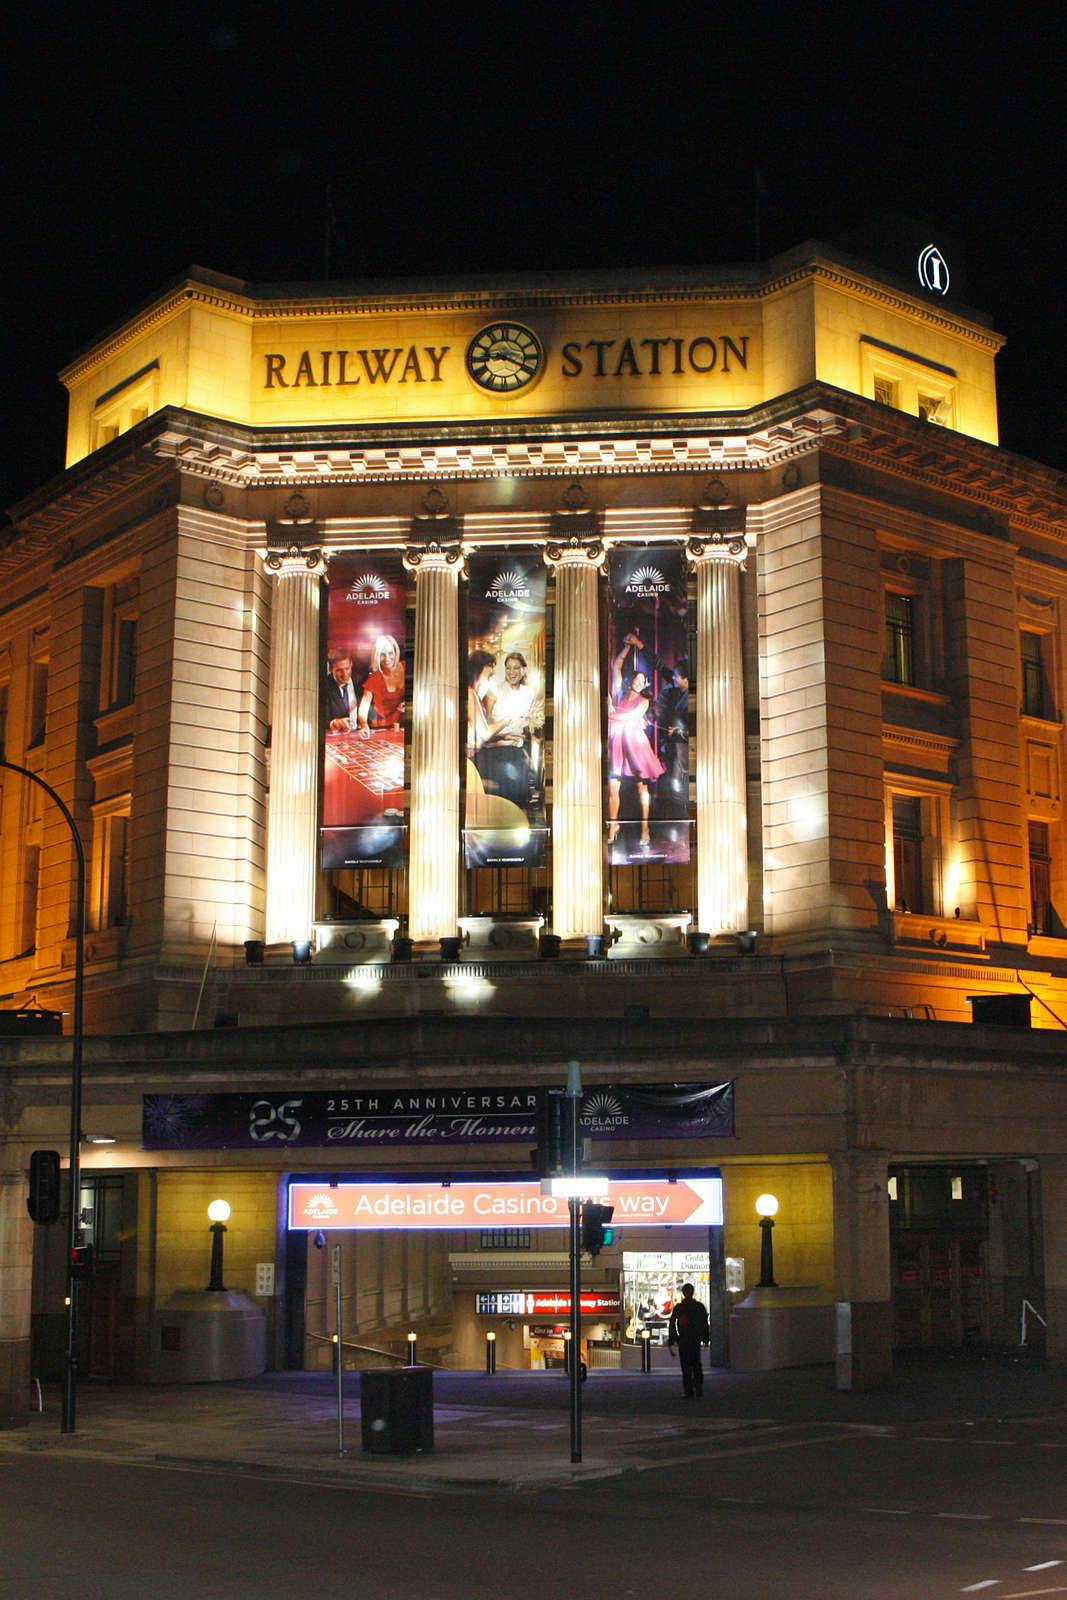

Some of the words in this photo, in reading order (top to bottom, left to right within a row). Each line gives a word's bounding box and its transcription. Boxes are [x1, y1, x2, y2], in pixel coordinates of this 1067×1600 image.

[264, 345, 450, 389] RAILWAY
[562, 336, 749, 377] STATION
[346, 592, 390, 600] ADELAIDE
[485, 590, 530, 598] ADELAIDE
[625, 584, 671, 593] ADELAIDE
[327, 1098, 379, 1111] 25TH
[393, 1095, 537, 1110] ANNIVERSAR
[249, 1100, 303, 1141] 25
[327, 1119, 401, 1140] Share
[404, 1114, 438, 1137] the
[441, 1117, 536, 1137] Momen
[354, 1194, 465, 1216] Adelaide
[473, 1193, 558, 1215] Casino
[618, 1196, 671, 1216] way
